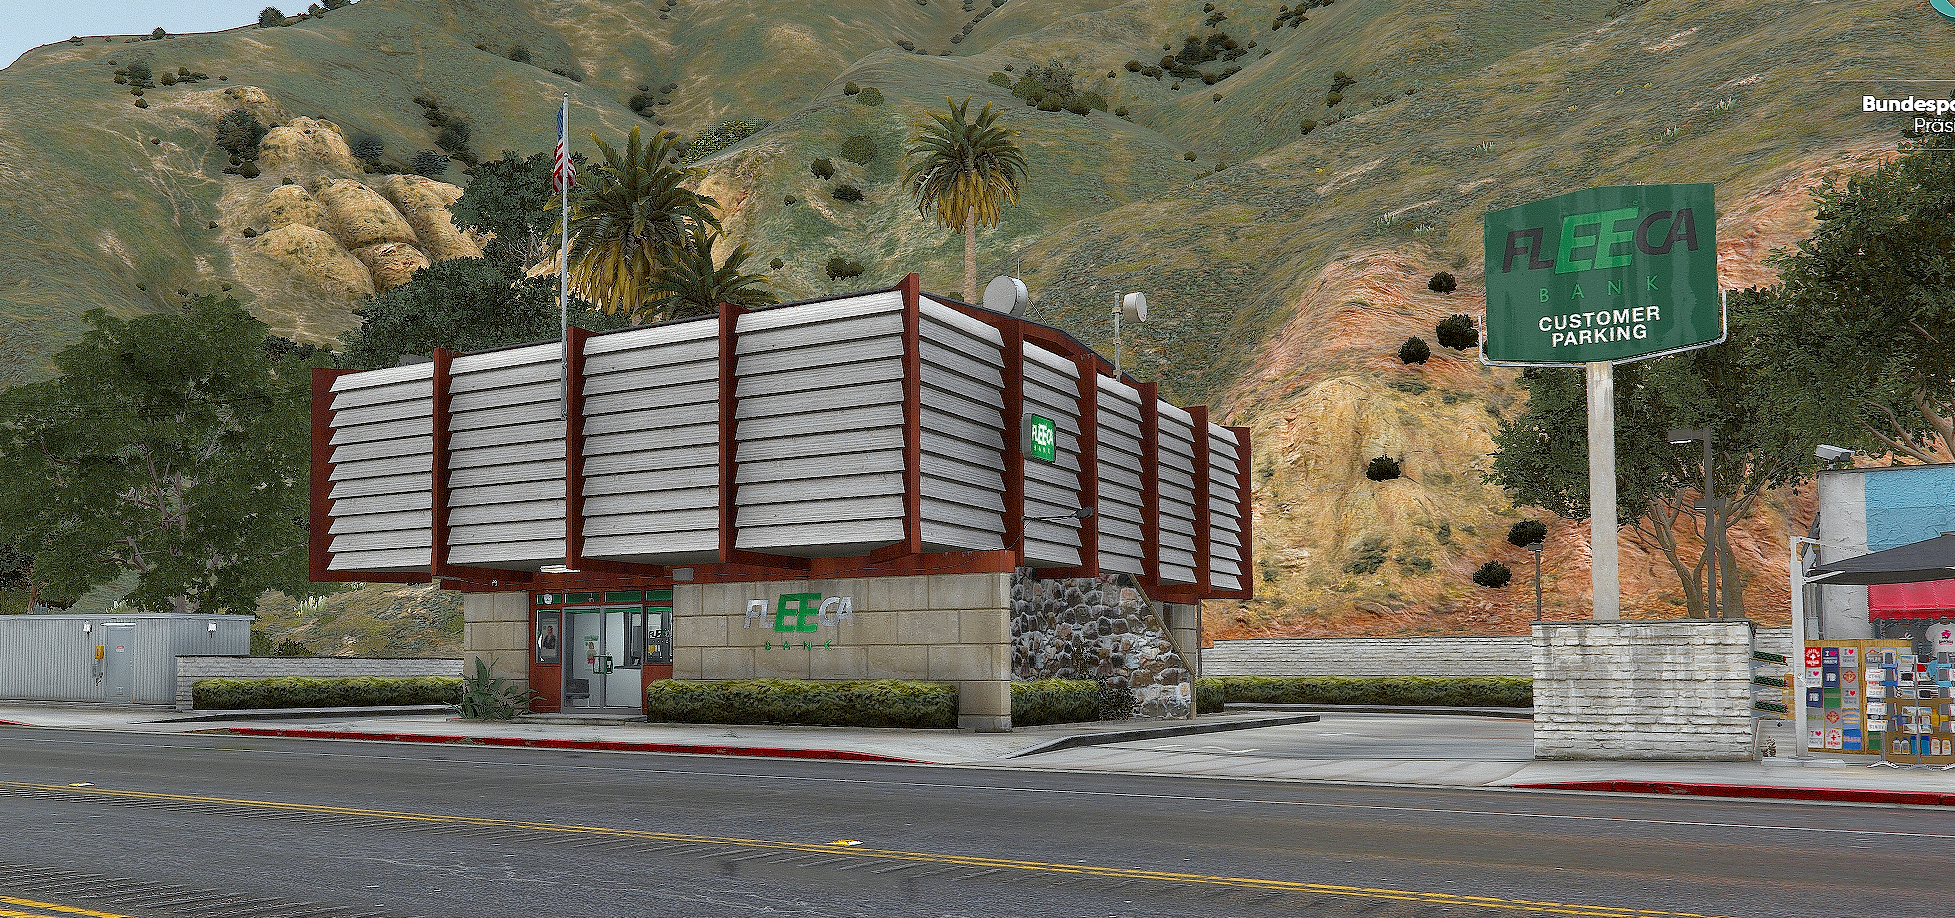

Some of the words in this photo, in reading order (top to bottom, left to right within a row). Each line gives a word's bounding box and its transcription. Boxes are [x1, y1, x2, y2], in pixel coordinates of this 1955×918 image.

[1502, 206, 1699, 275] FLEECA
[1539, 275, 1659, 303] BANK
[1538, 305, 1661, 333] CUSTOMER
[1552, 323, 1648, 348] PARKING
[1031, 423, 1055, 447] FLEECA
[743, 592, 855, 633] FLEECA
[764, 640, 832, 651] BANK
